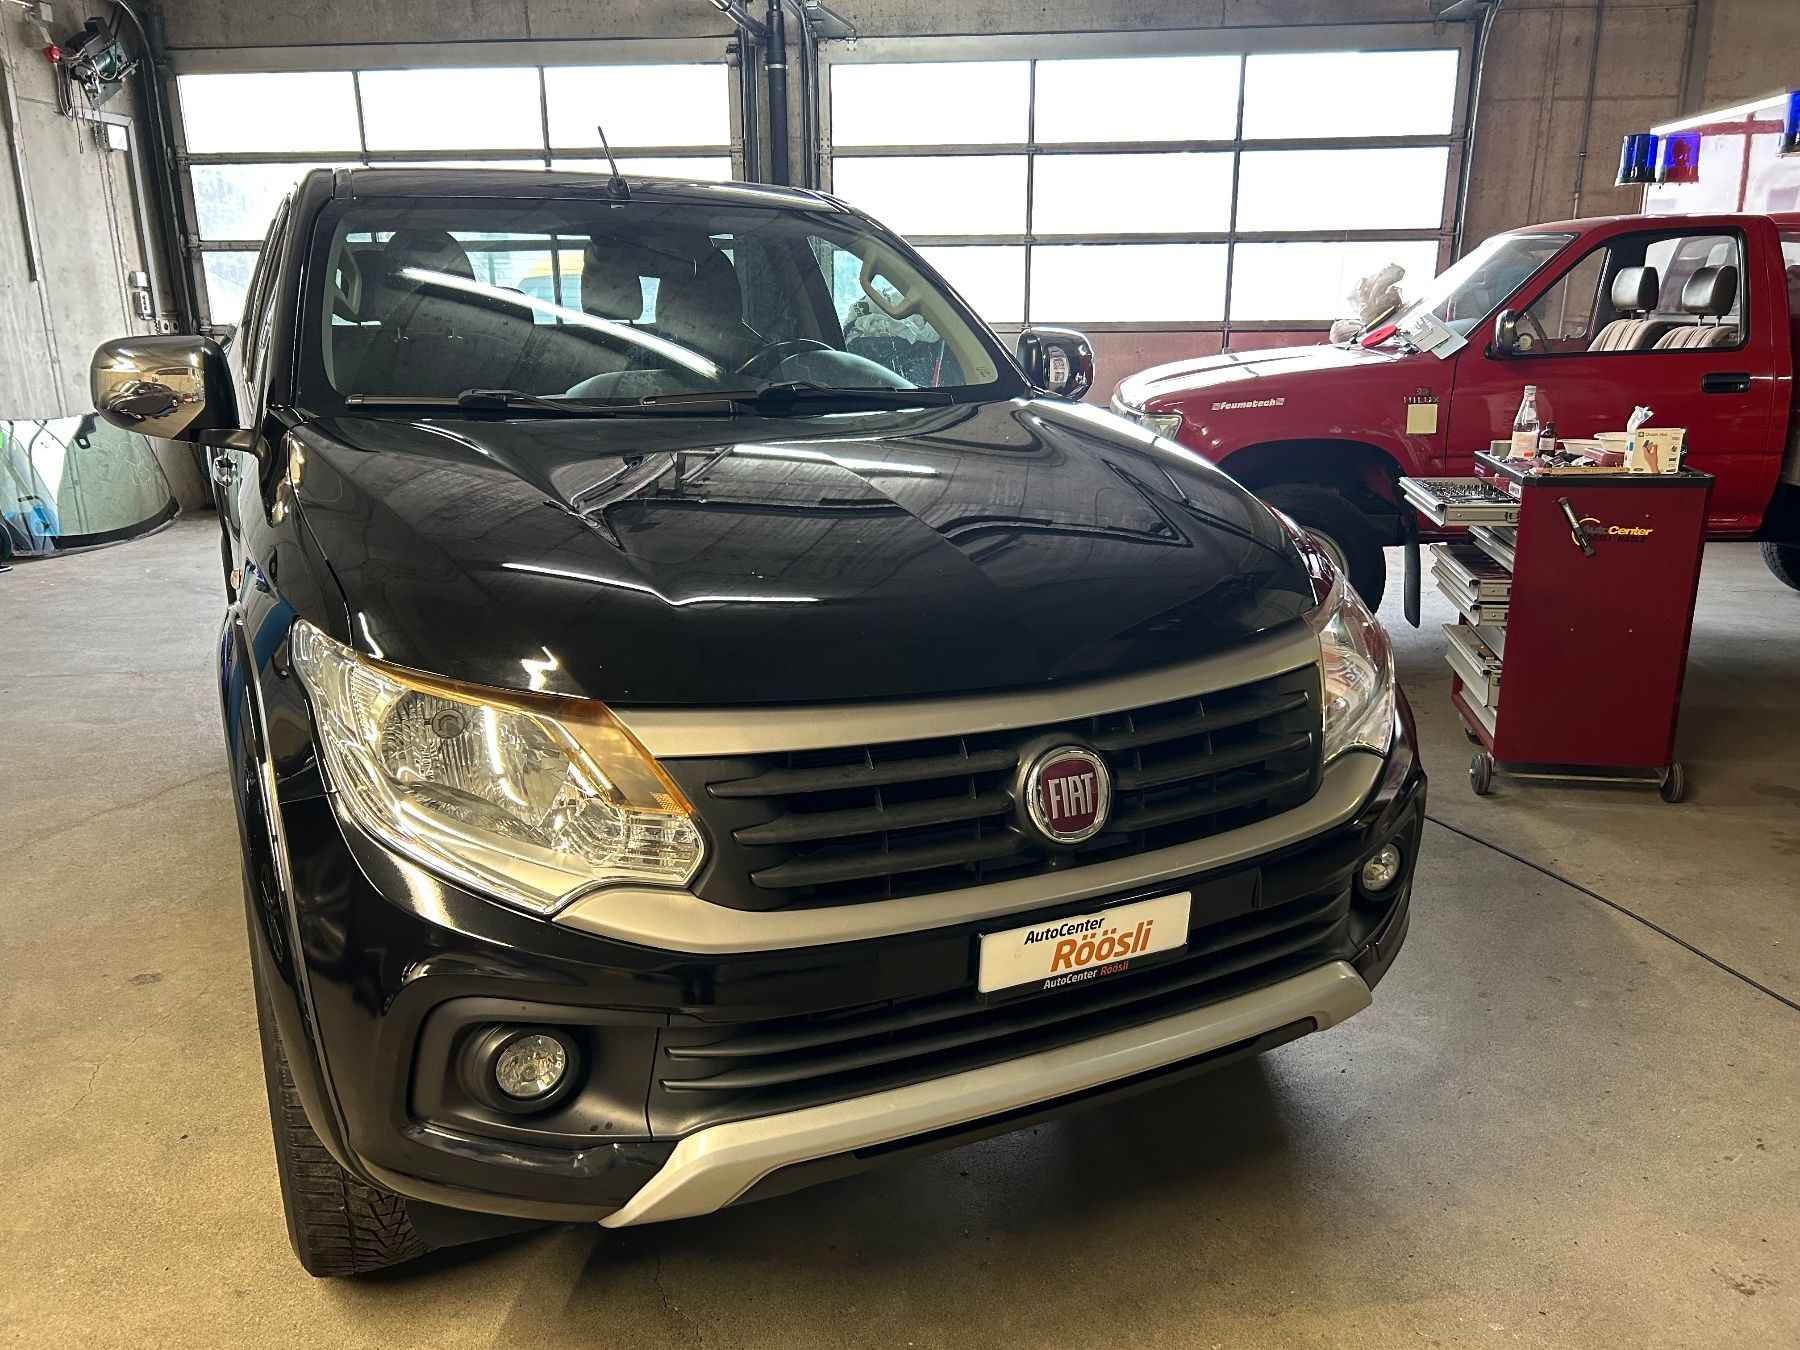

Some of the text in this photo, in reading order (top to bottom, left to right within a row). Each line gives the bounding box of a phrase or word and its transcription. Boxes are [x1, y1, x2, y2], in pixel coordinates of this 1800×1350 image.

[1047, 772, 1094, 820] FIAT
[1024, 917, 1105, 945] AutoCenter
[1050, 919, 1154, 973] Röösli
[1043, 961, 1129, 989] AutoCenter Röösli
